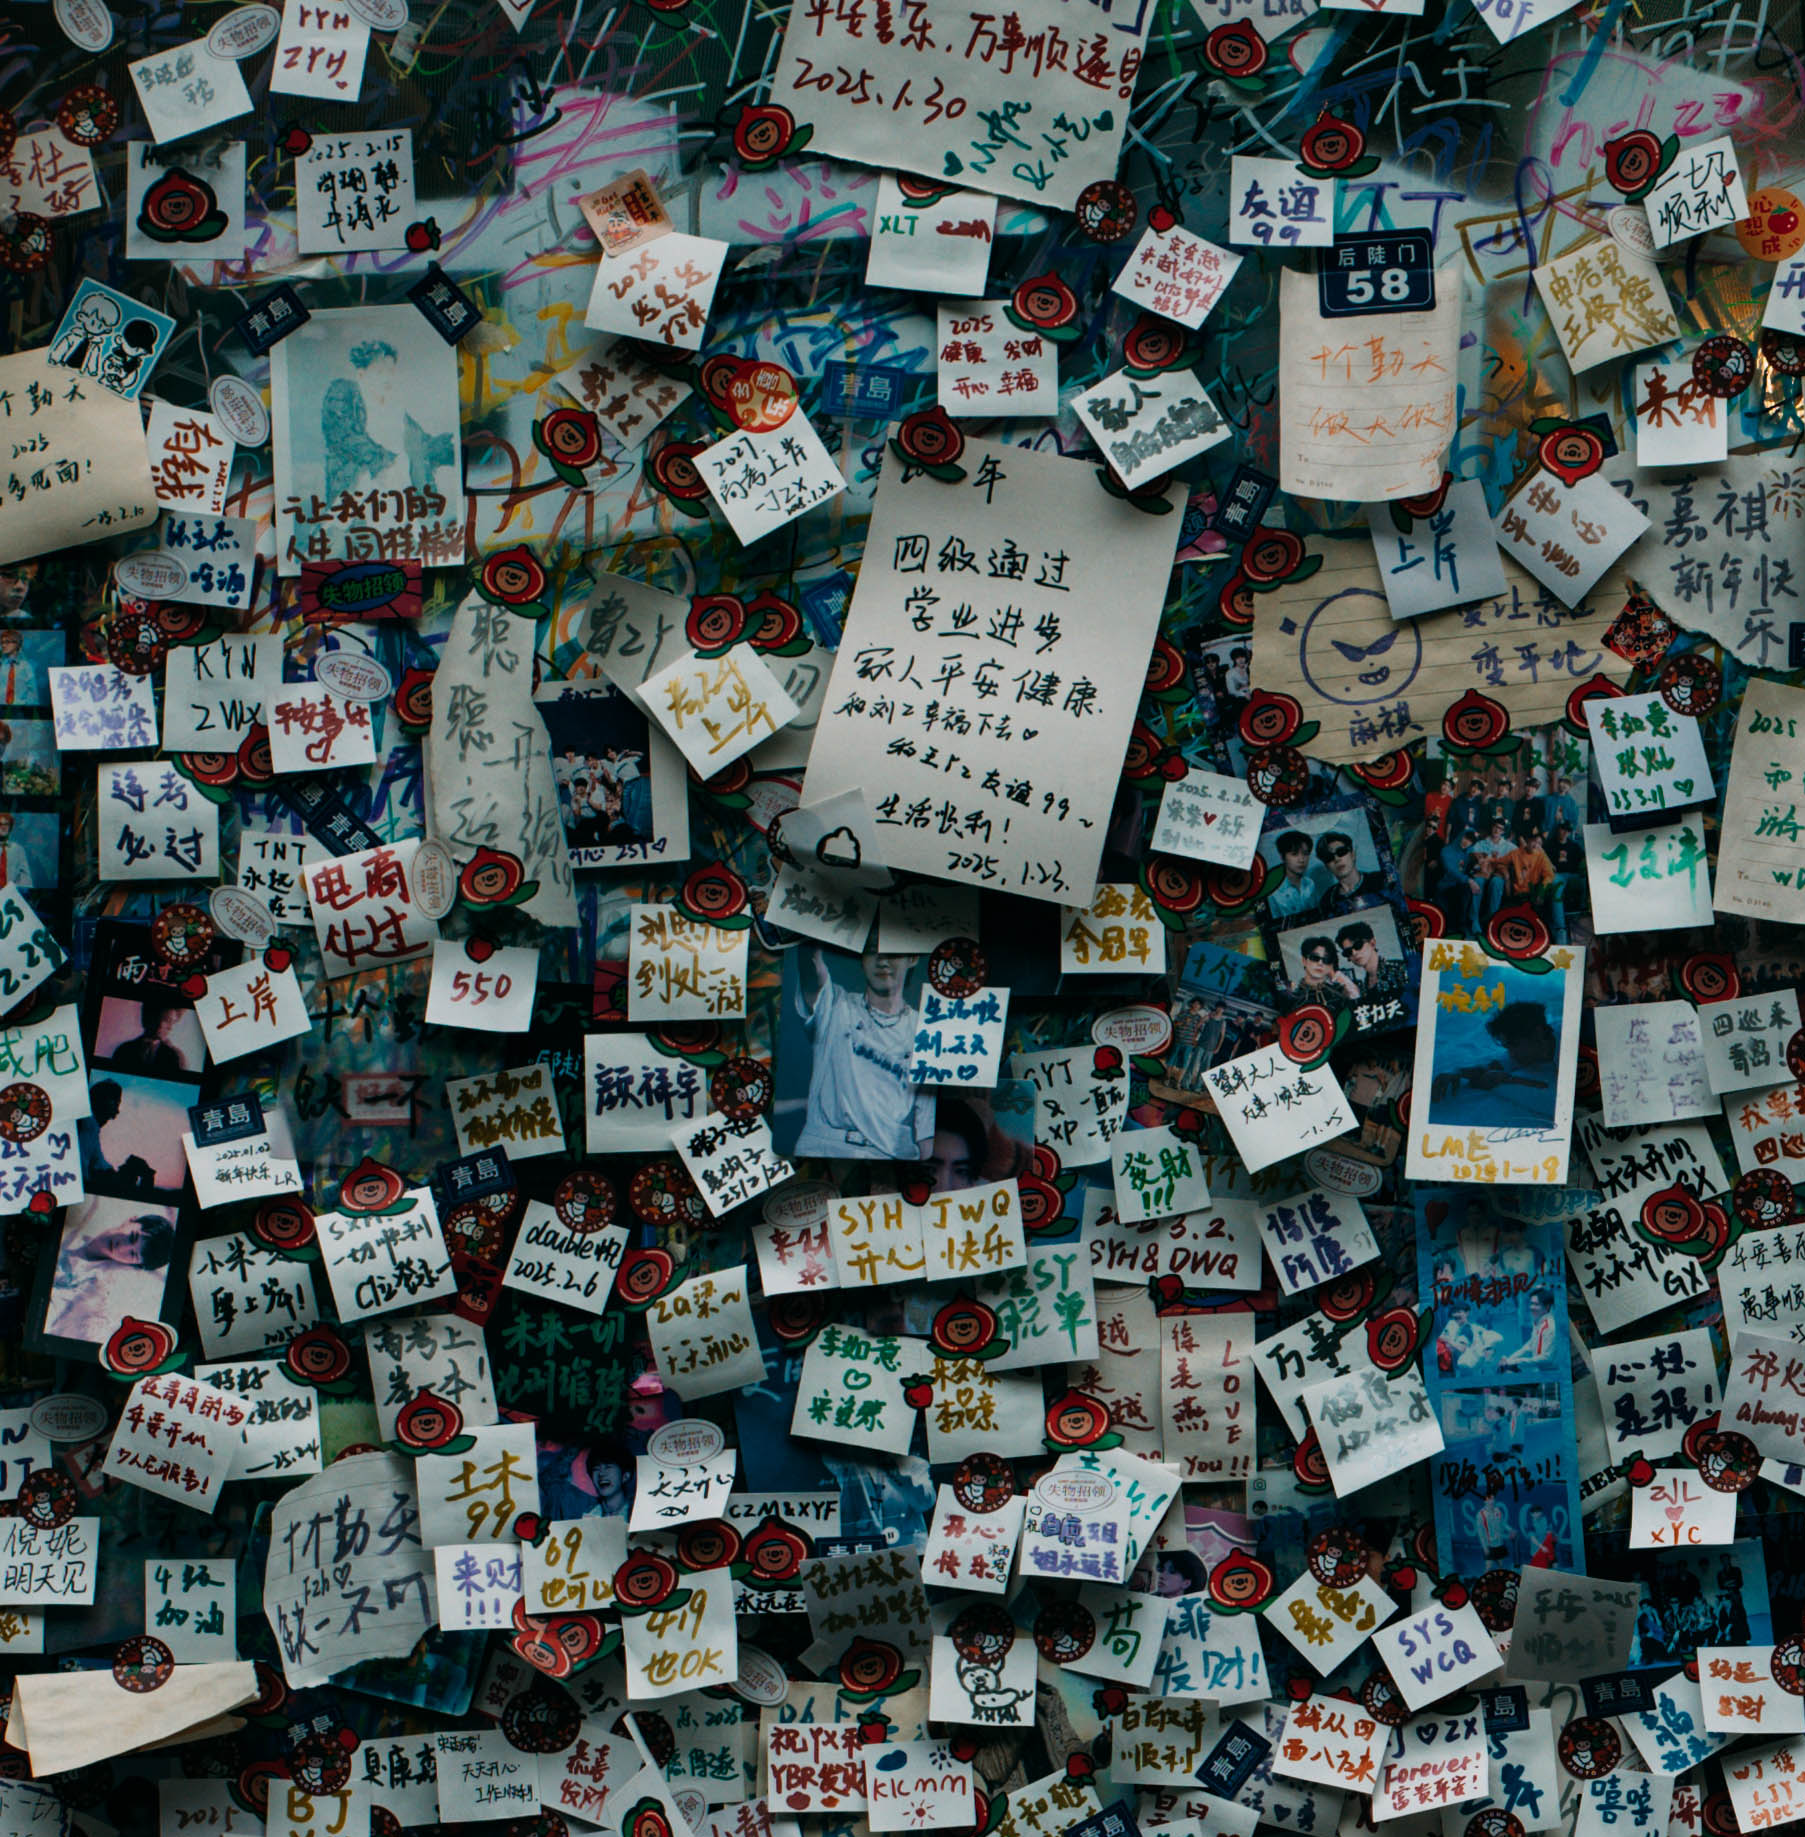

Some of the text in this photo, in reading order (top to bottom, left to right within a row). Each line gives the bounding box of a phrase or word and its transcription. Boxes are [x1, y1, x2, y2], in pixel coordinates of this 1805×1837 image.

[1239, 180, 1326, 223] 友谊
[1336, 245, 1417, 268] 后陡门
[1346, 269, 1411, 303] 58
[247, 299, 295, 336] 青島
[425, 279, 466, 328] 青島
[839, 370, 894, 401] 青島
[1225, 478, 1261, 528] 青島
[201, 1106, 253, 1133] 青島
[449, 1158, 503, 1191] 青島
[1595, 1680, 1641, 1705] 青島
[1211, 1736, 1255, 1781] 青島
